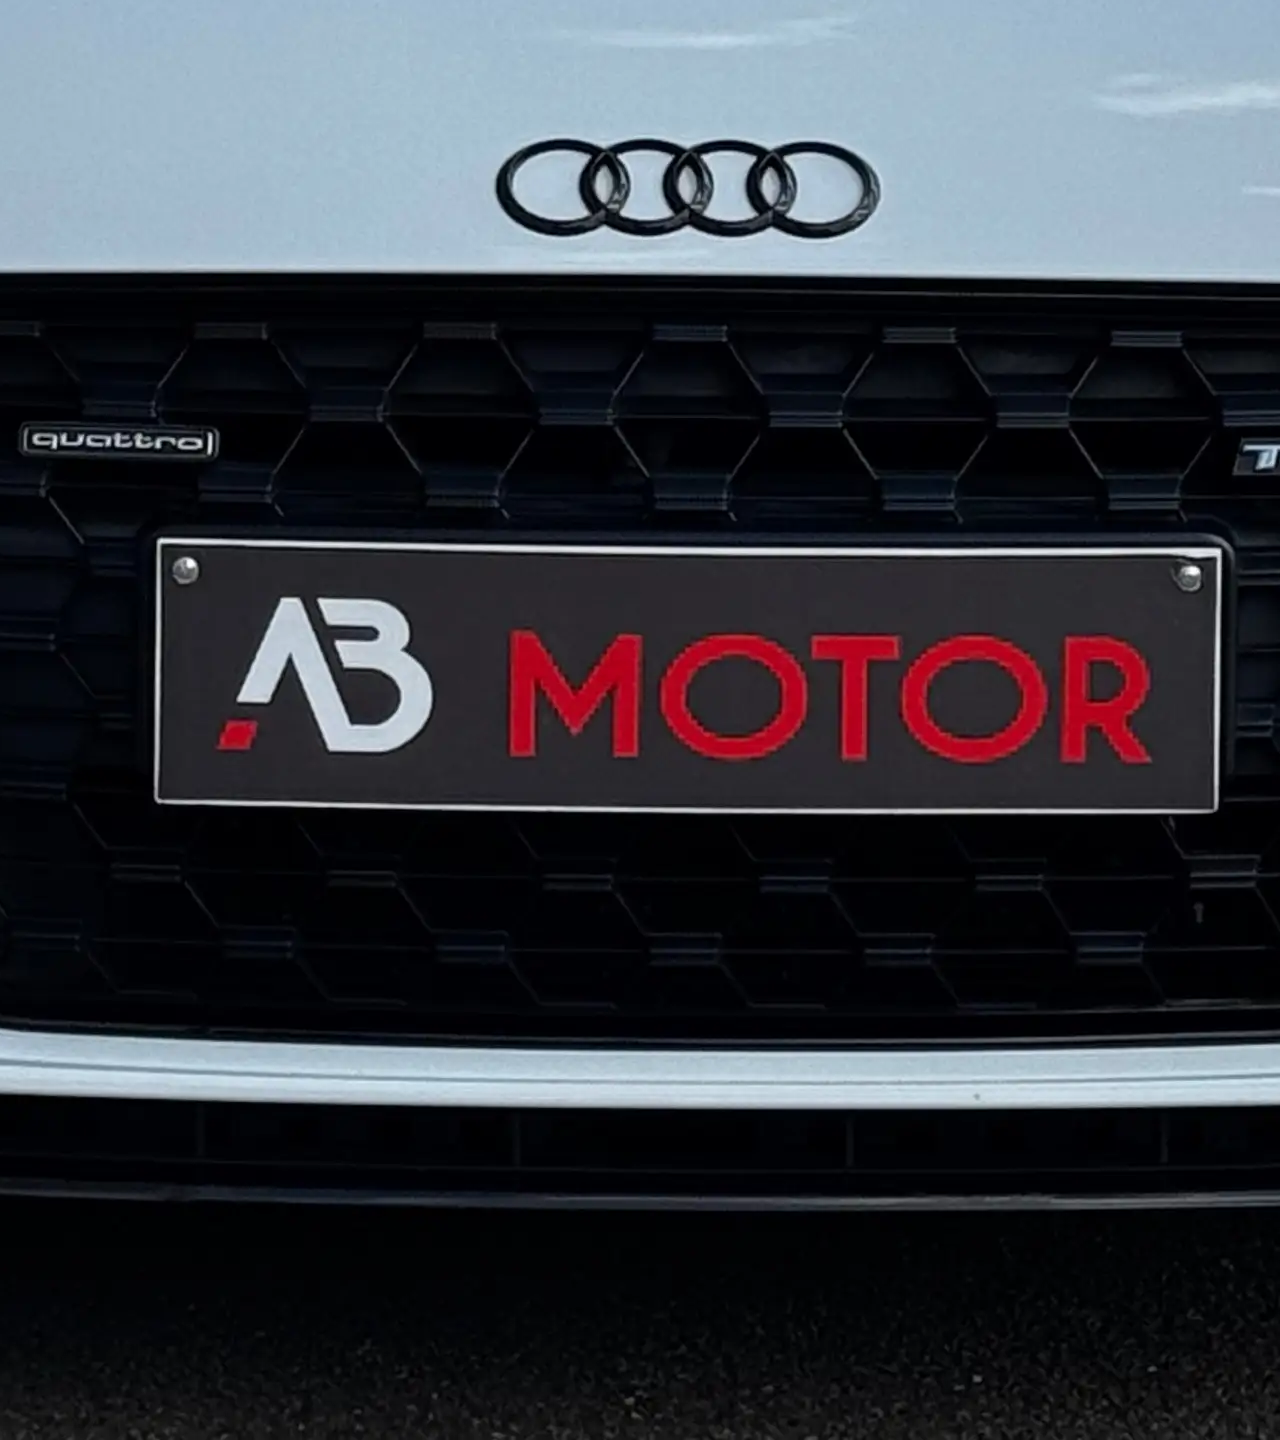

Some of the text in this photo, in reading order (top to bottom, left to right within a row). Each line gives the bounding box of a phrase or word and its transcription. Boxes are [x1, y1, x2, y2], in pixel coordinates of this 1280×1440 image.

[32, 432, 204, 450] quattro
[217, 596, 1153, 764] AB MOTOR
